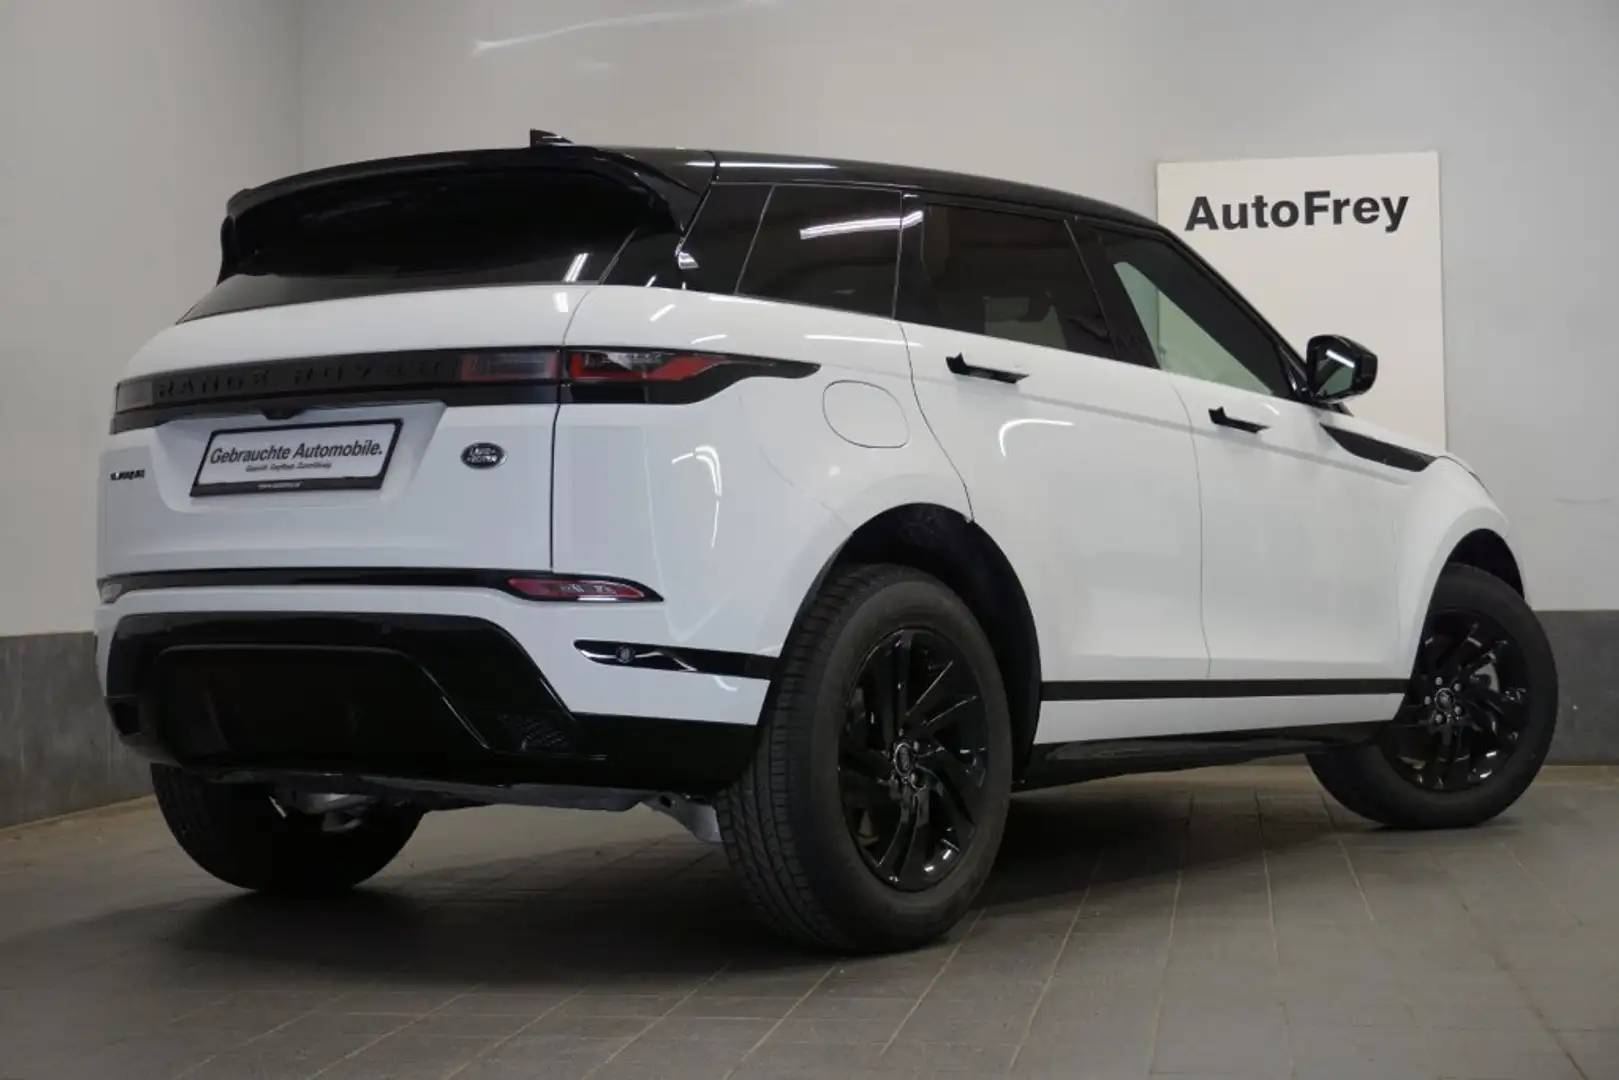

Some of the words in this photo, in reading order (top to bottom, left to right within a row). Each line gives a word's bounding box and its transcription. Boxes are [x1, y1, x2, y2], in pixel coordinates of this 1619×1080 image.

[1184, 190, 1409, 233] AutoFrey
[210, 444, 291, 464] Gebrauchte
[293, 439, 382, 459] Automobile.
